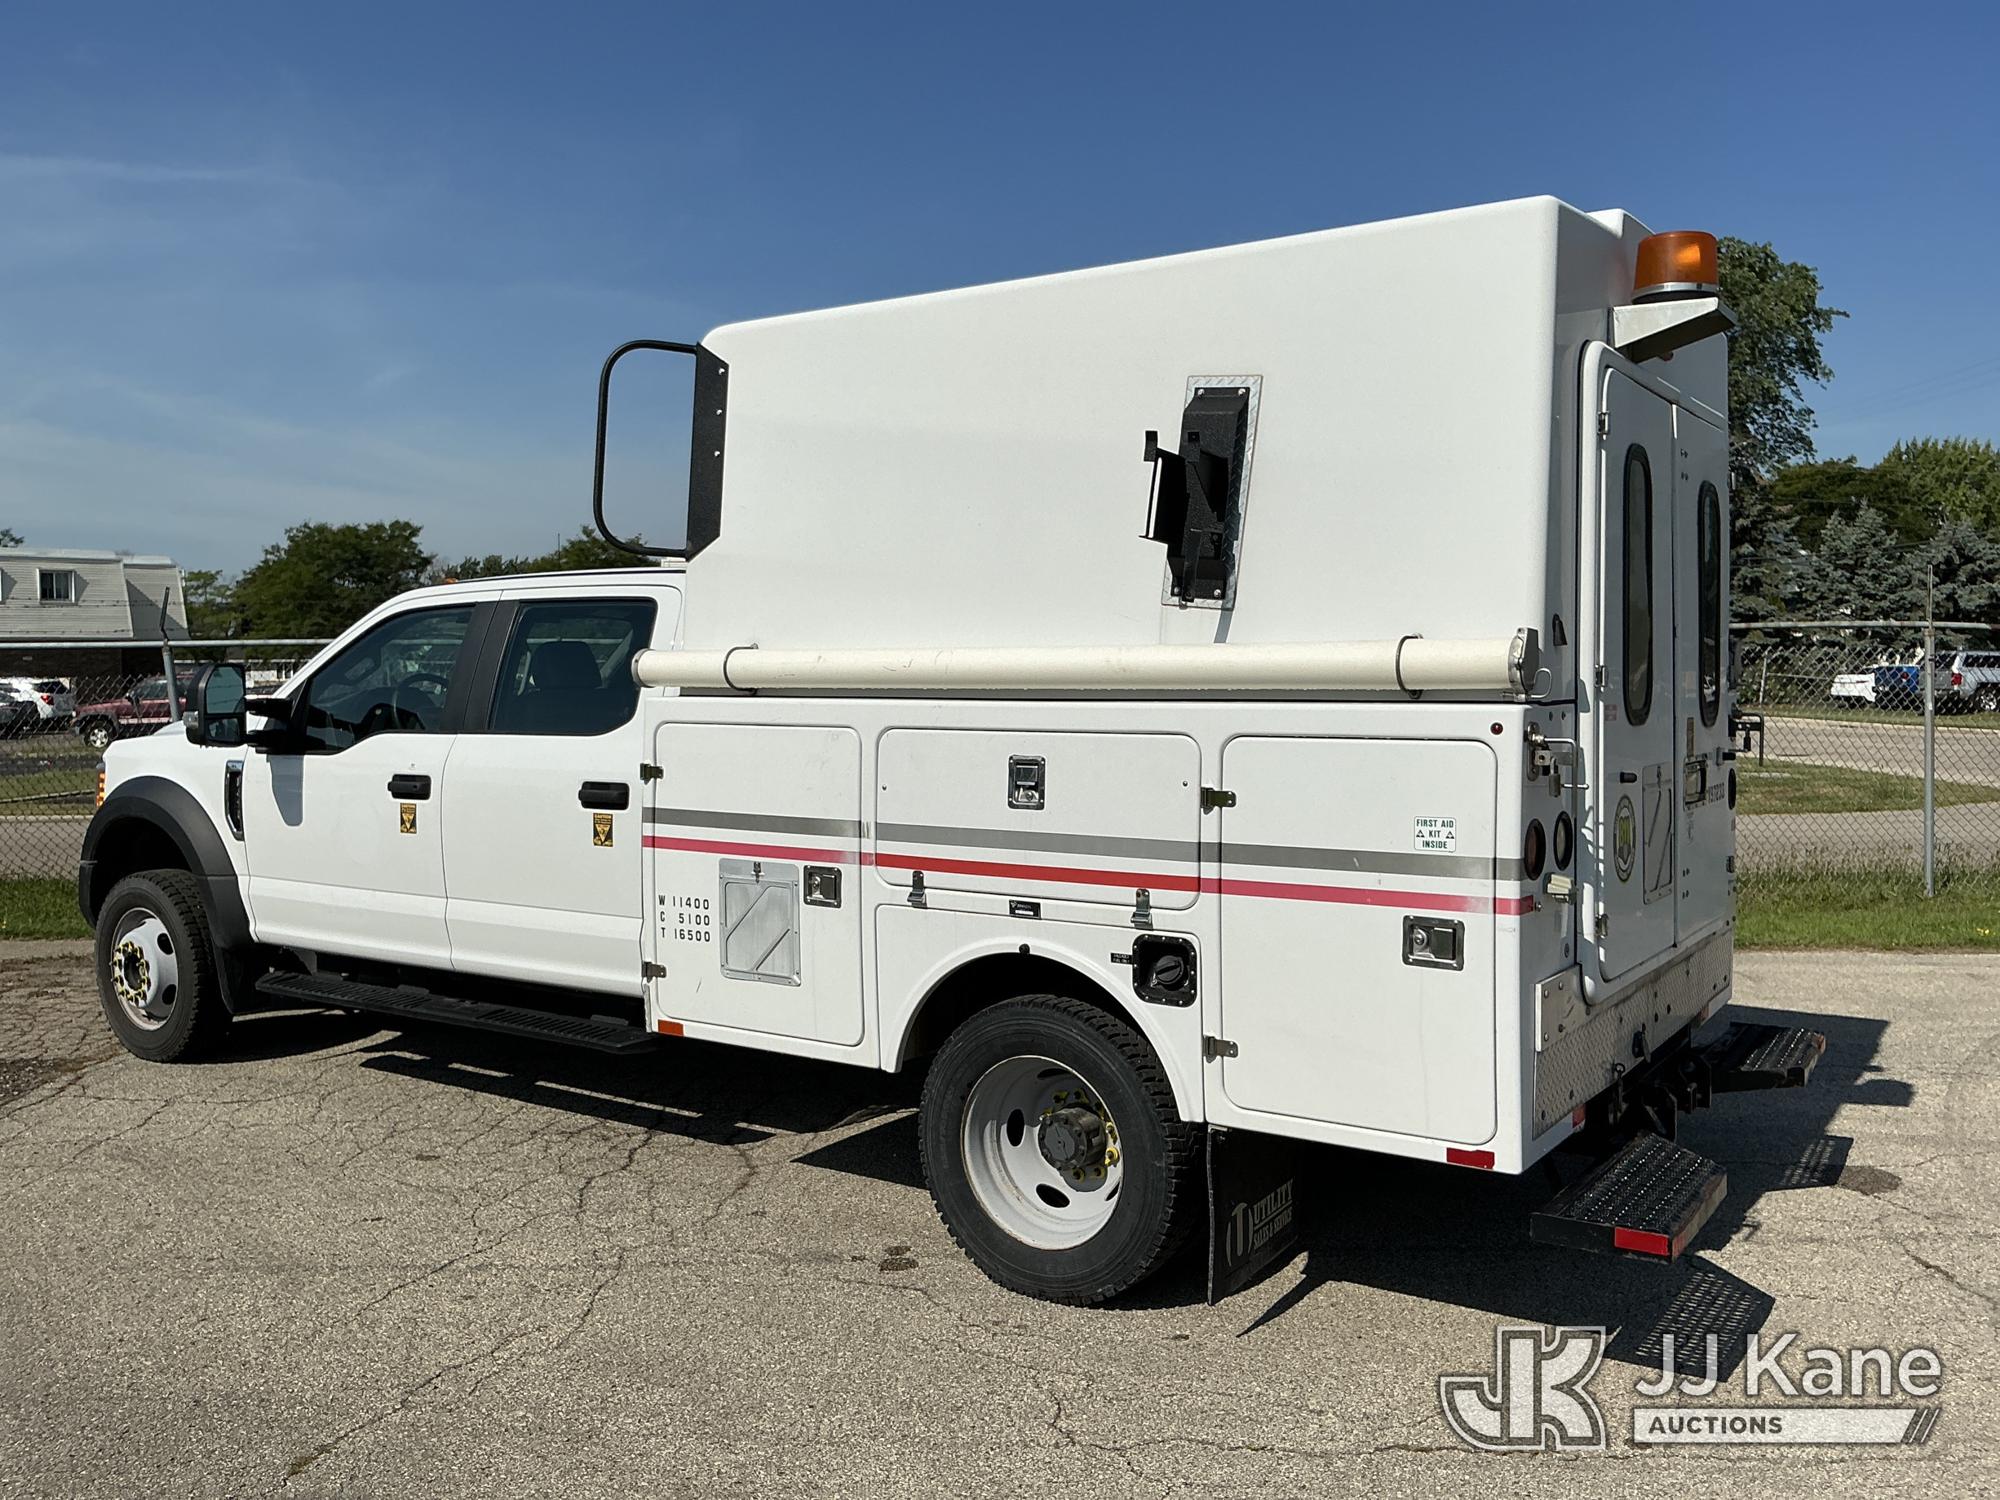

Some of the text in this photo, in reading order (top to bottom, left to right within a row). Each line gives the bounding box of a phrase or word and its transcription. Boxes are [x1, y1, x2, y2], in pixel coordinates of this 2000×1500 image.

[1416, 818, 1454, 828] FIRST AID
[1428, 829, 1441, 838] KIT
[1422, 840, 1448, 849] INSIDE
[658, 895, 709, 910] W 11400
[660, 911, 710, 926] C 5100
[661, 927, 711, 942] T 16500
[1253, 1178, 1293, 1224] UTILITY
